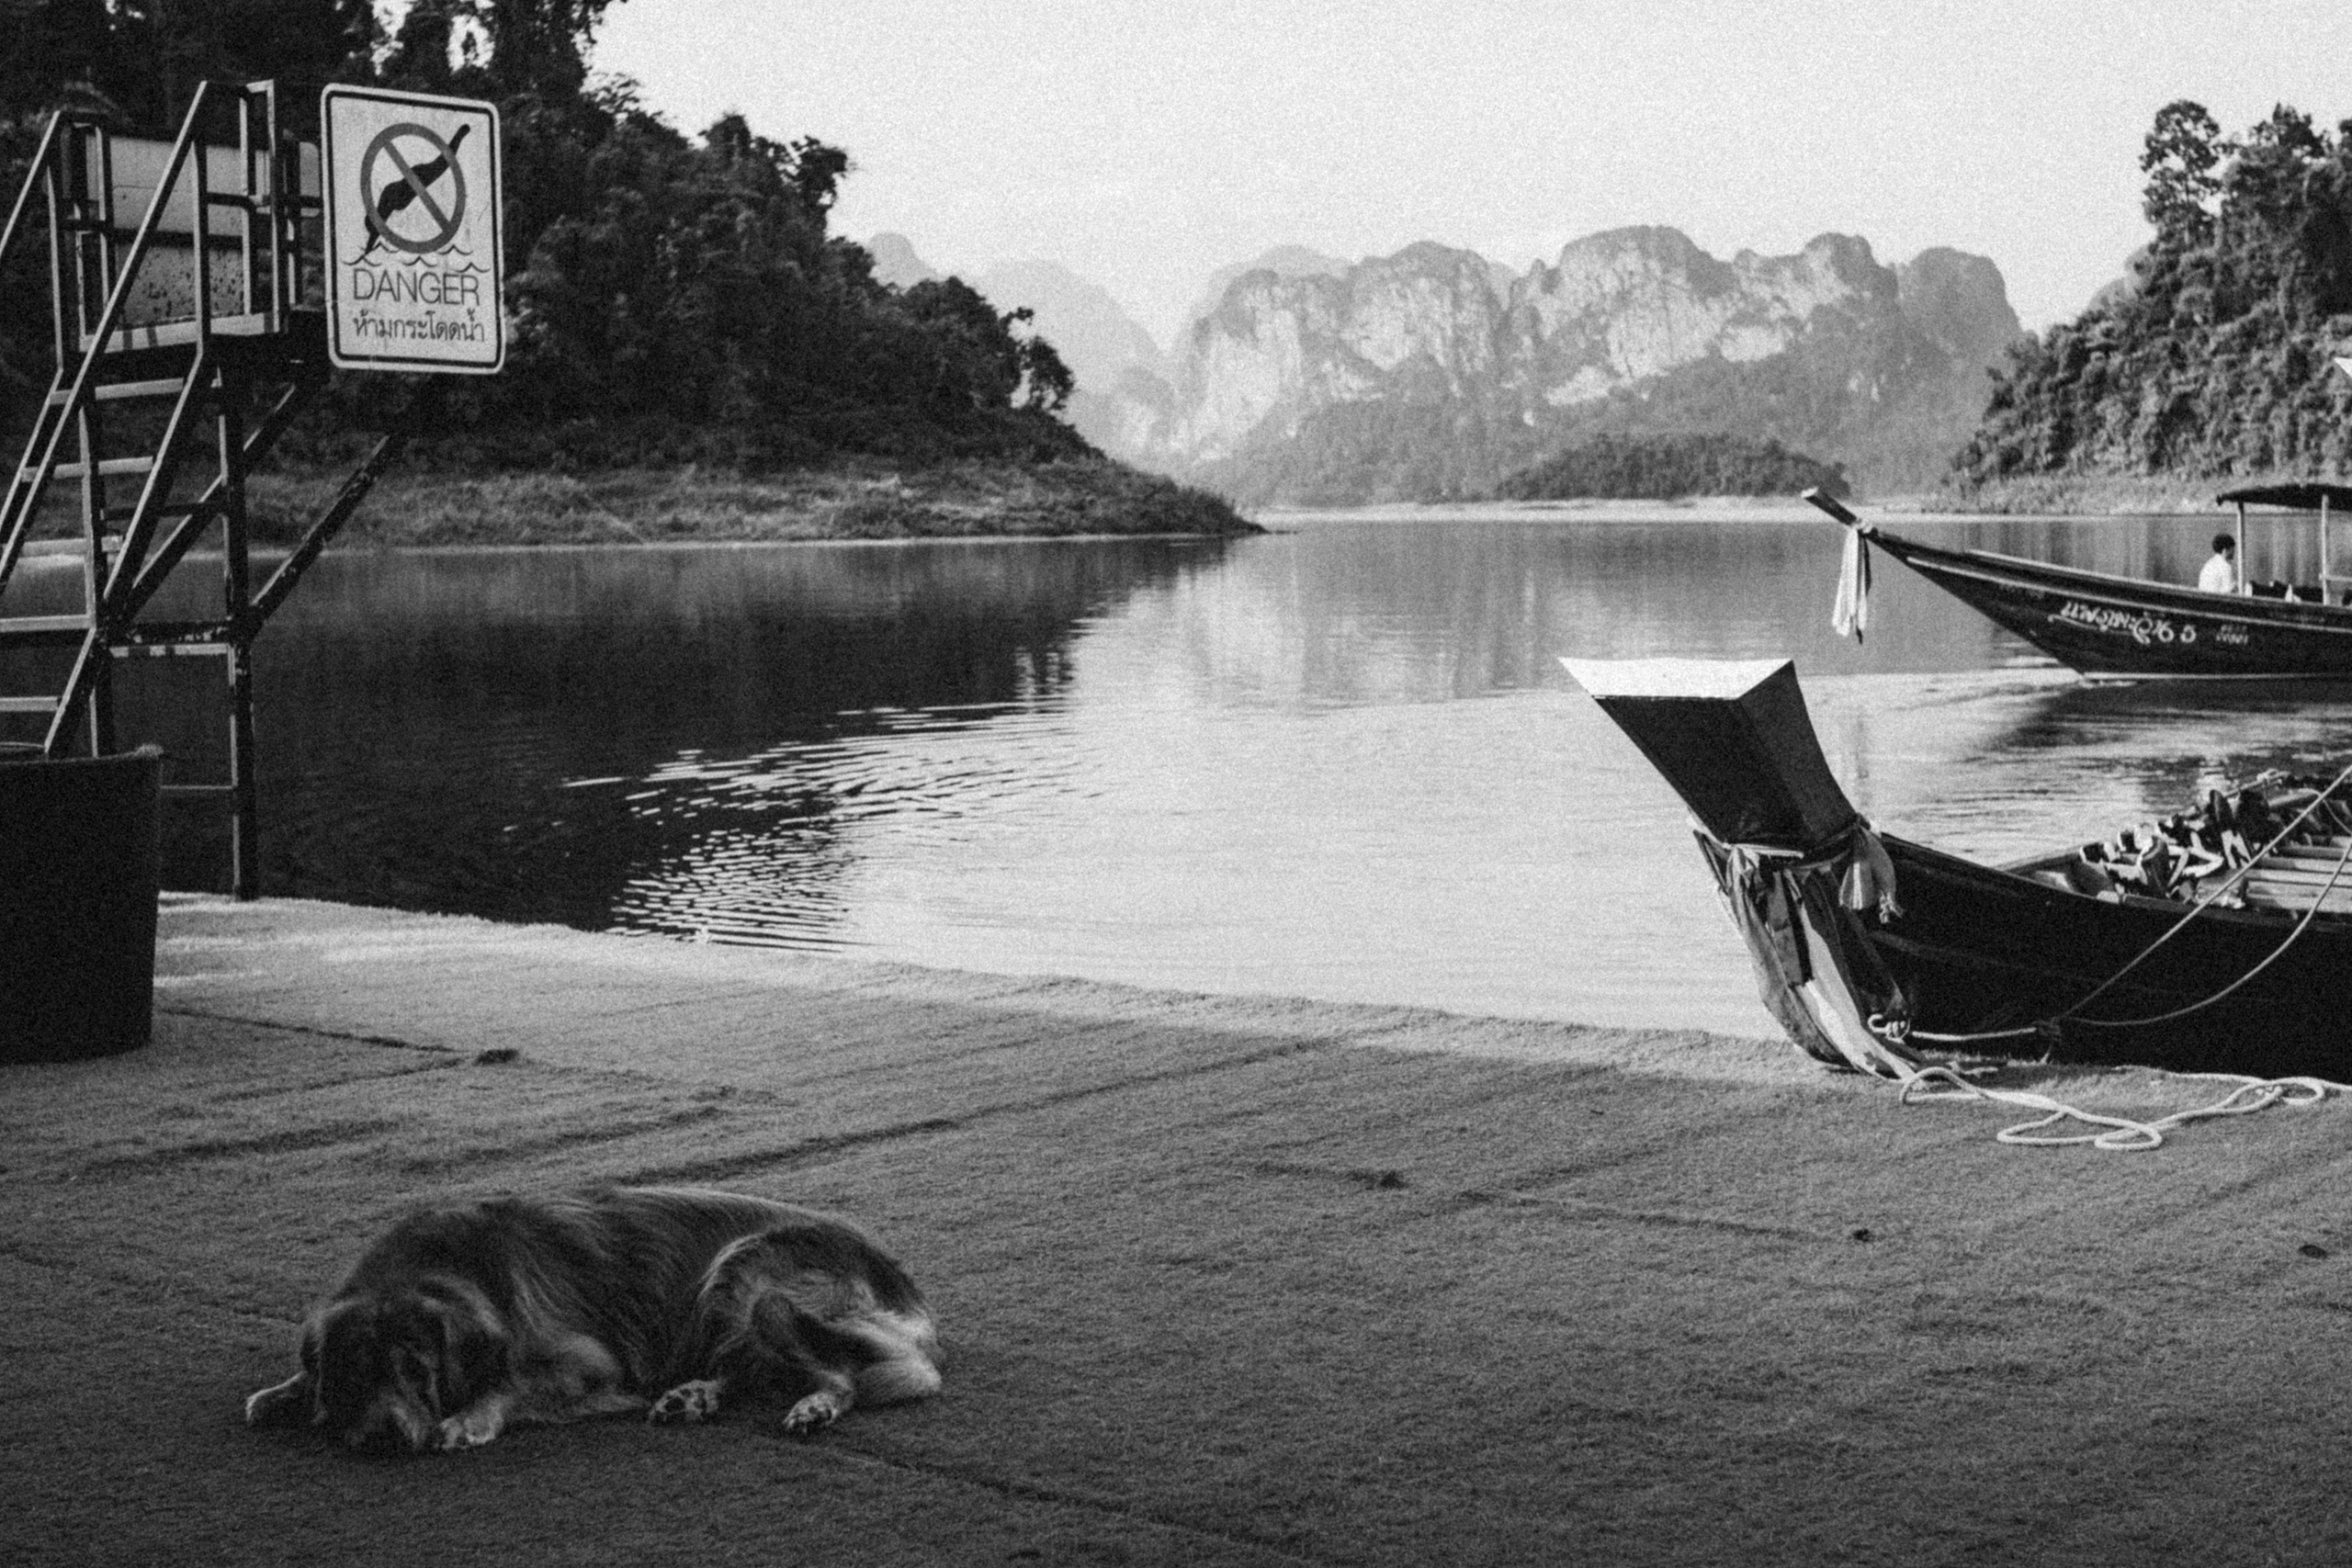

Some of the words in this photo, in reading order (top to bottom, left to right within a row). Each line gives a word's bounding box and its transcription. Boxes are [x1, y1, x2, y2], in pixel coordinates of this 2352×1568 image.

[354, 268, 480, 306] DANGER
[353, 308, 485, 343] ห้ามกระโดดน้ำ
